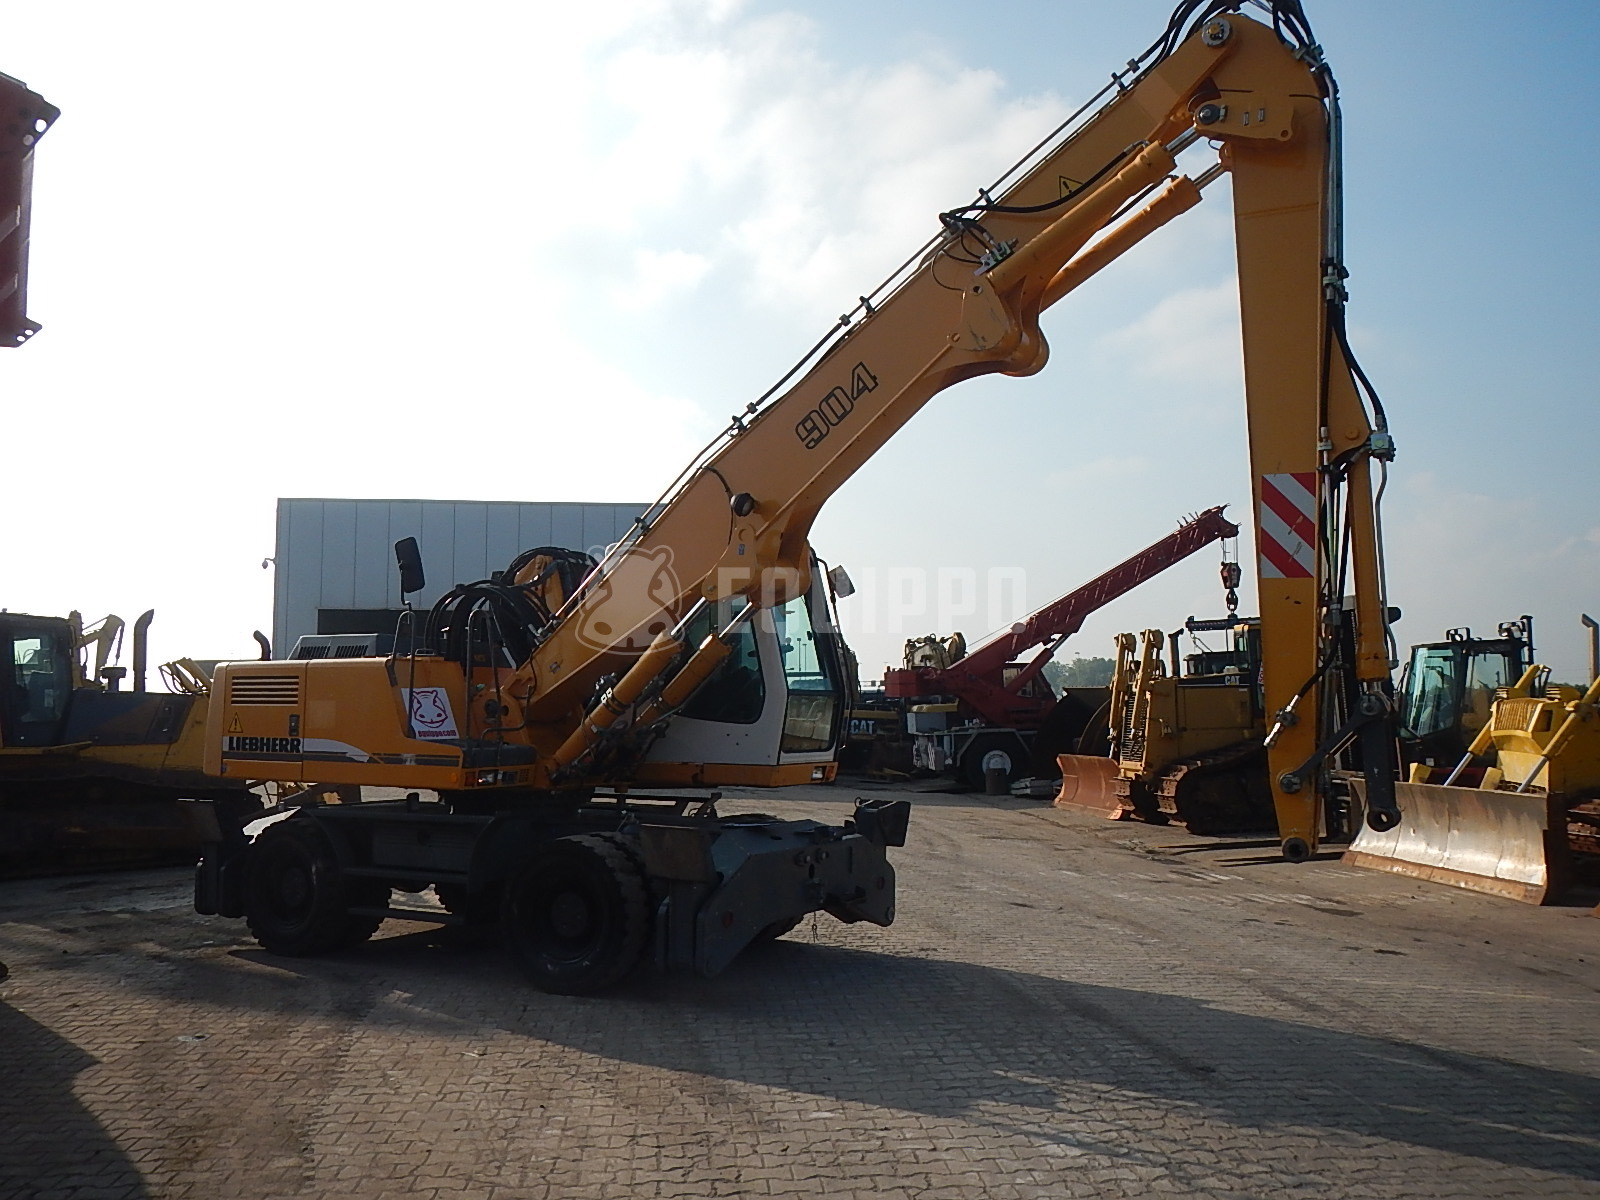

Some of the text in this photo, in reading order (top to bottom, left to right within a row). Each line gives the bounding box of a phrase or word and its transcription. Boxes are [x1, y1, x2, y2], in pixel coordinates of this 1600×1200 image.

[795, 361, 879, 449] 904
[1224, 675, 1241, 686] CAT
[850, 719, 875, 735] CAT
[228, 736, 301, 754] LIEBHERR
